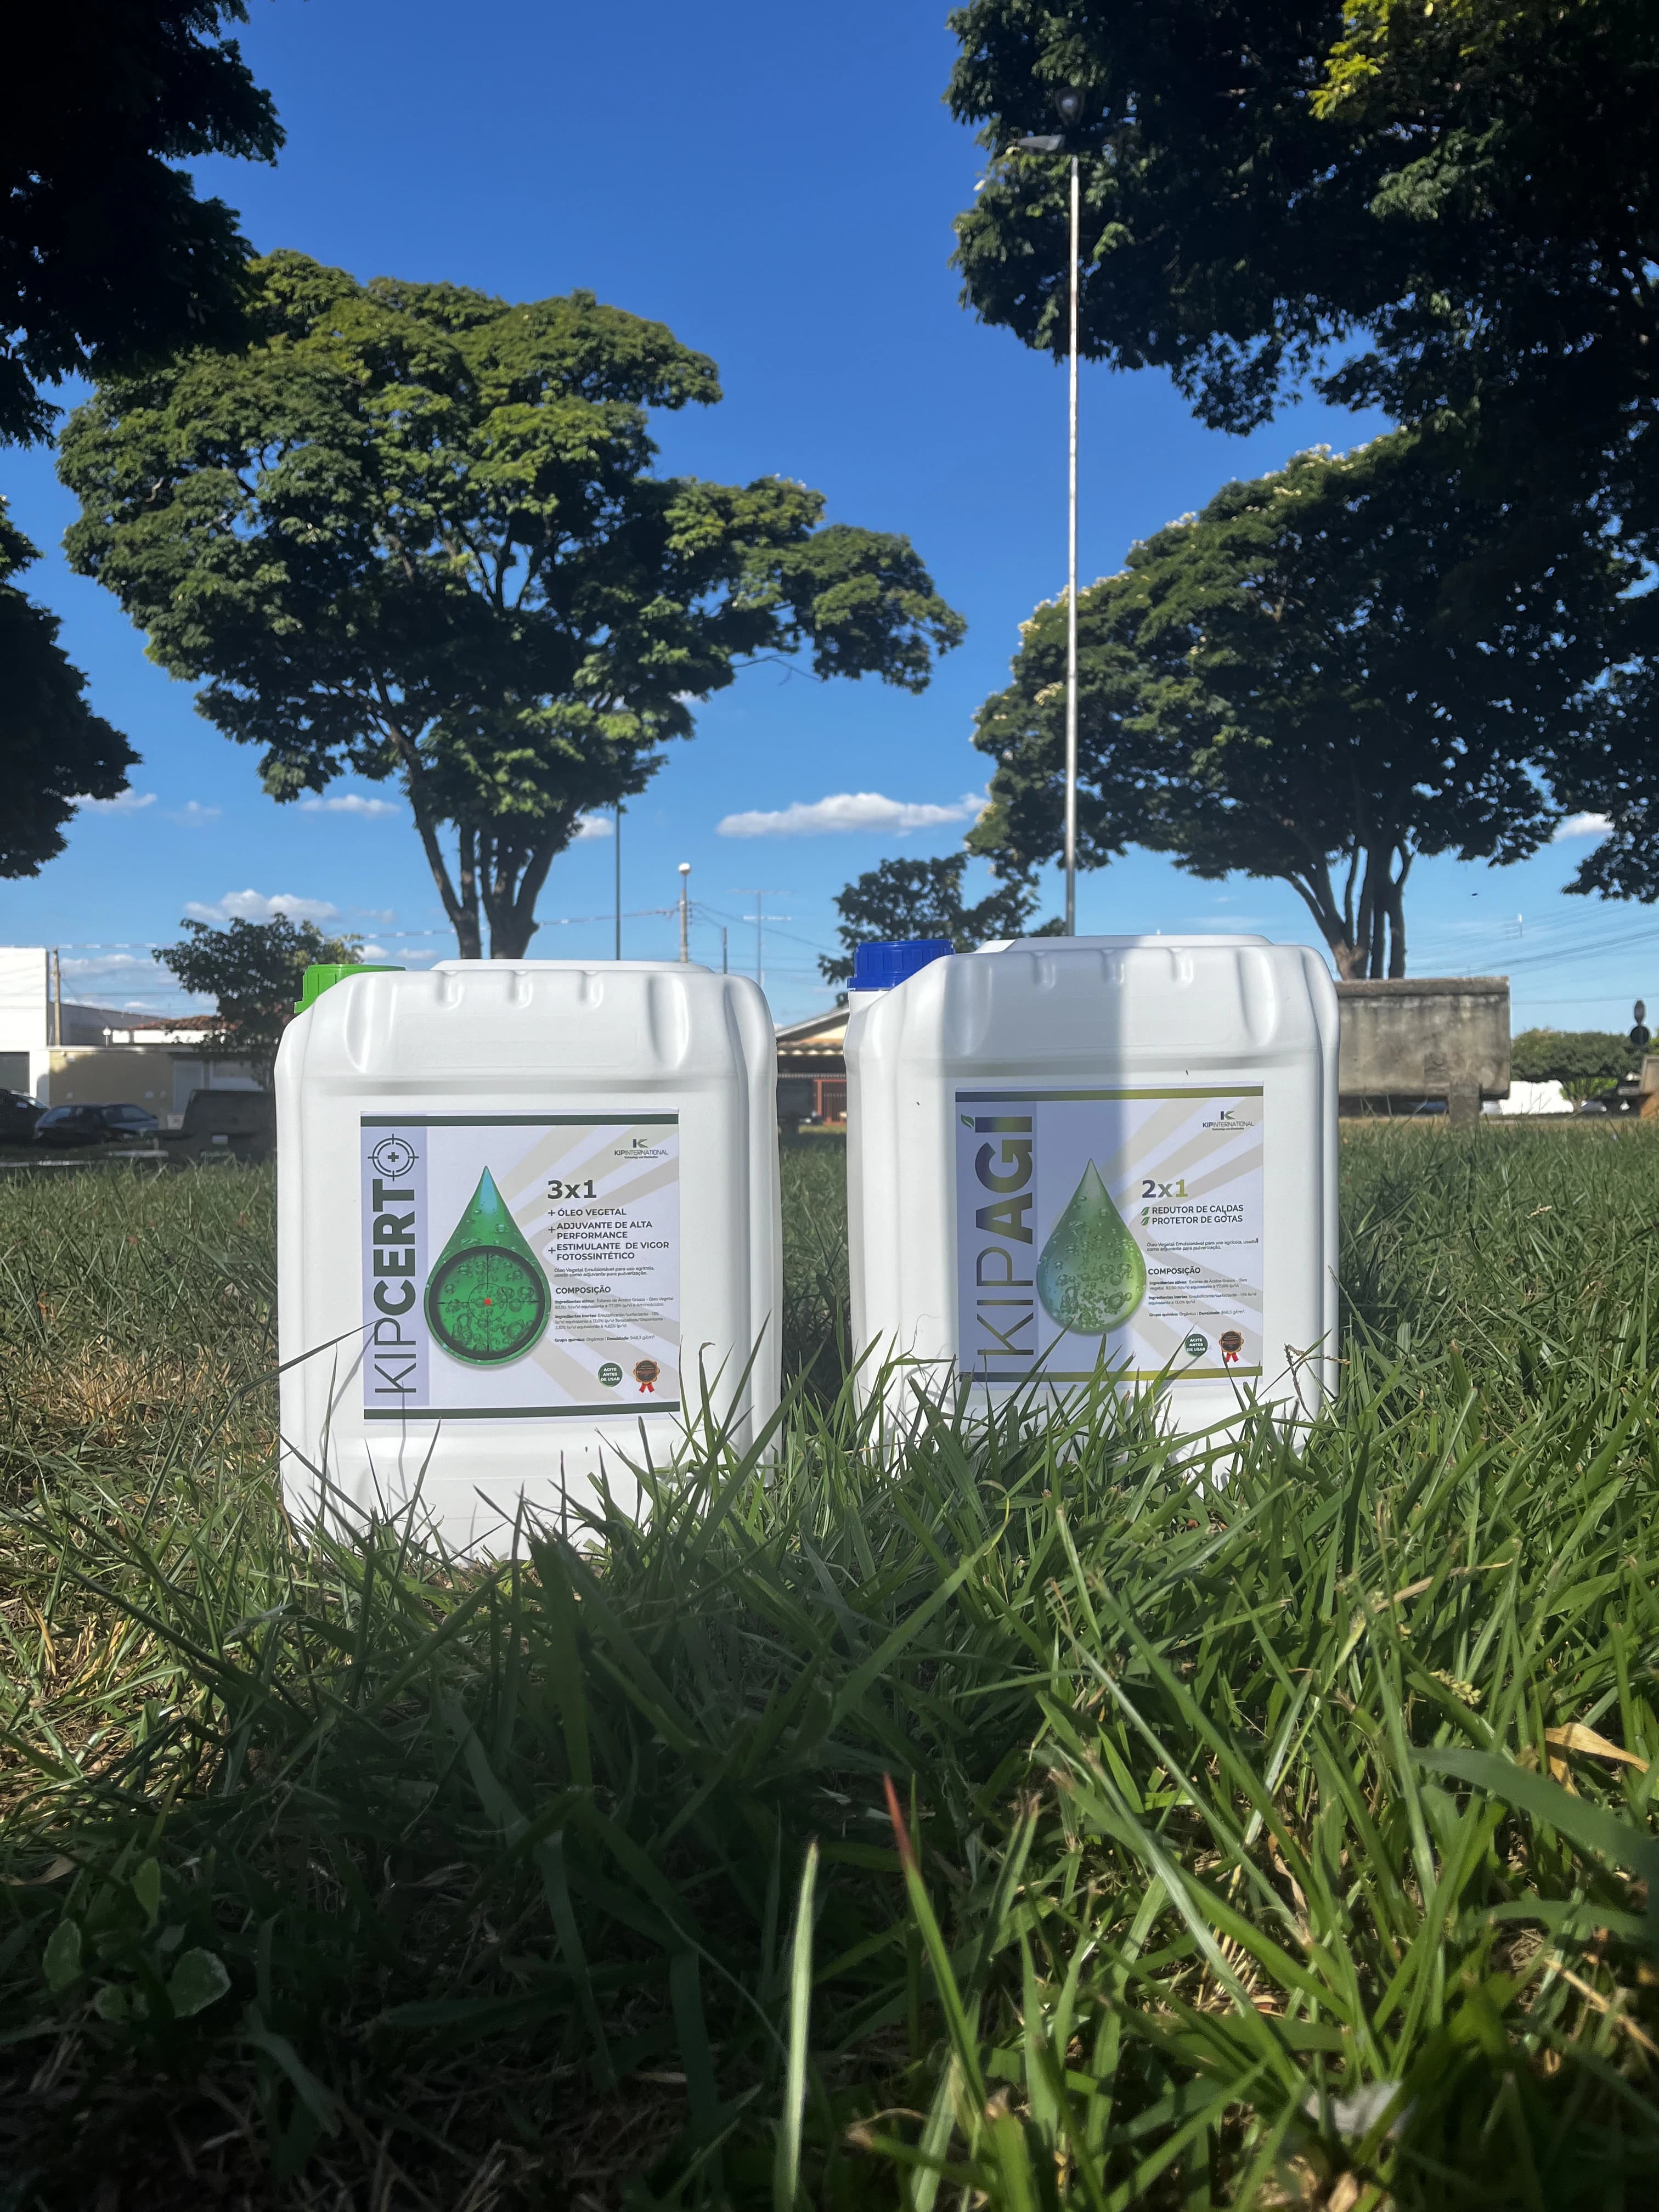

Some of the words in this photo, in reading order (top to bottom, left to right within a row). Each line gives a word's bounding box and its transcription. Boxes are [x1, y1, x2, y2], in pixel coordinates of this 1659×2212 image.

[548, 1180, 597, 1199] 3x1
[1142, 1179, 1188, 1198] 2x1
[557, 1208, 583, 1216] ÓLEO
[1210, 1204, 1244, 1212] CALDAS
[557, 1251, 635, 1261] FOTOSSINTÉTICO
[1148, 1266, 1201, 1276] COMPOSIÇÃO
[555, 1285, 611, 1295] COMPOSIÇÃO
